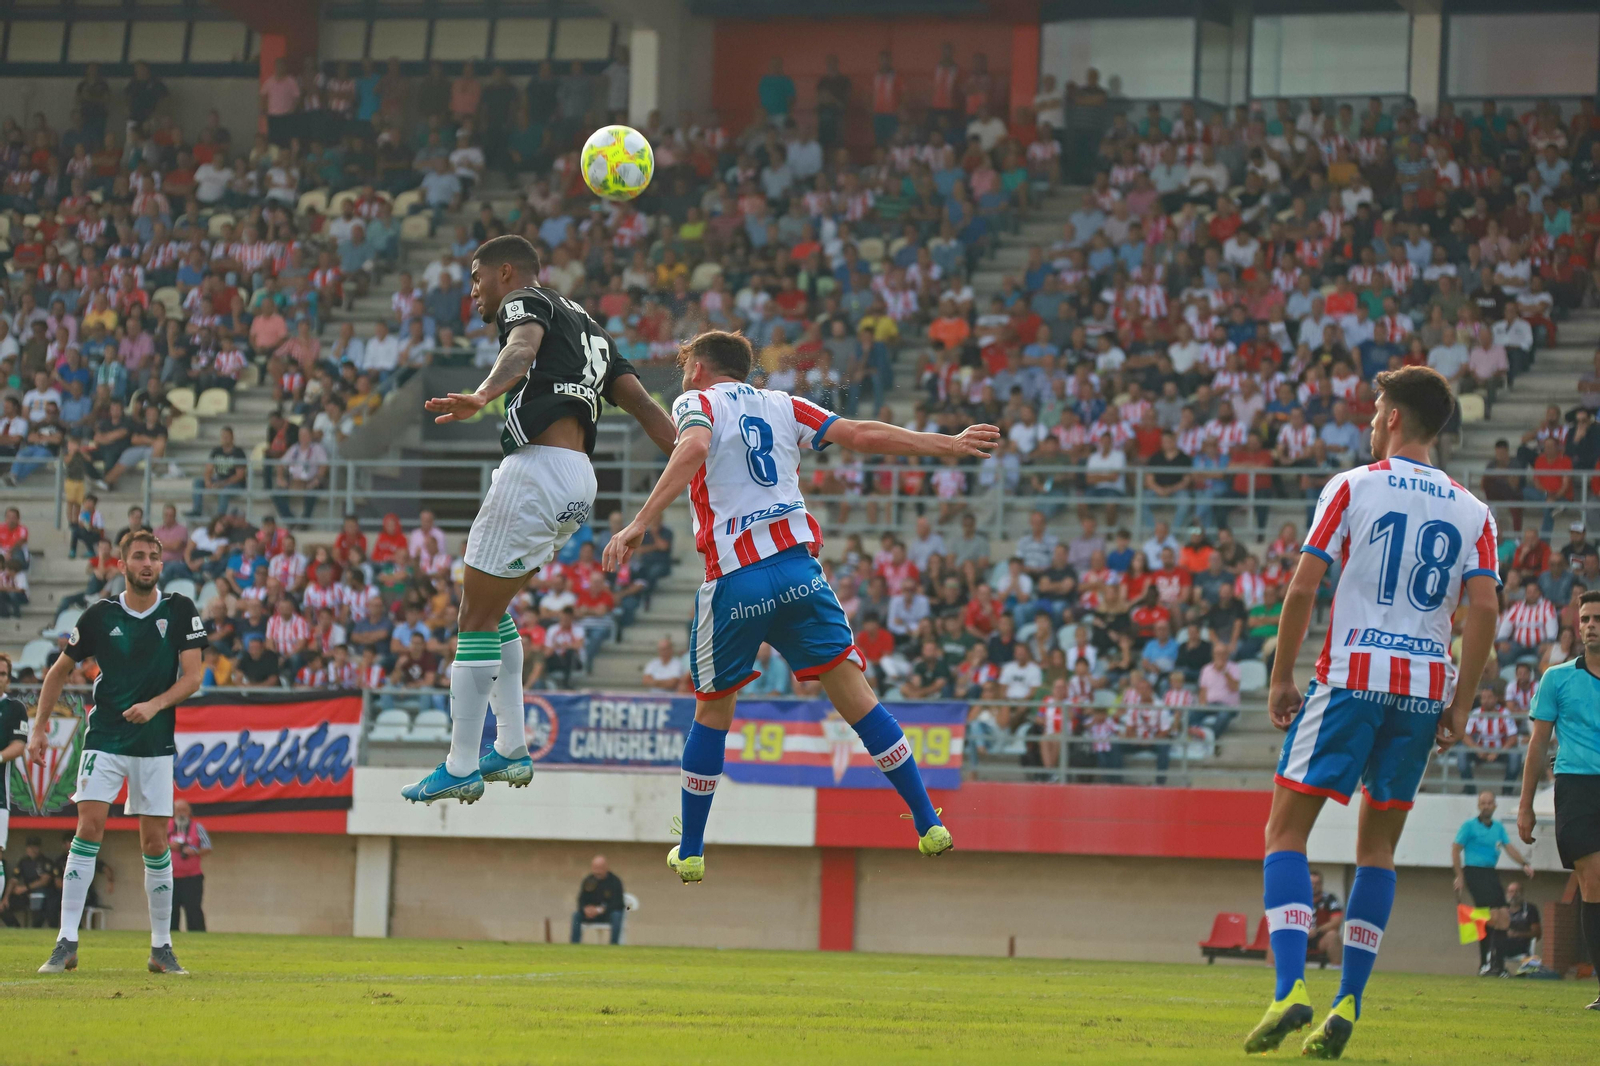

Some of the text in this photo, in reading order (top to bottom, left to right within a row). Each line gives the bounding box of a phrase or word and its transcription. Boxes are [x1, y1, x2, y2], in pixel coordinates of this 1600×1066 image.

[739, 414, 778, 488] 8
[1387, 475, 1456, 501] CATURLA
[1369, 510, 1462, 612] 18
[588, 700, 673, 731] FRENTE
[173, 721, 353, 791] ecirista
[740, 722, 786, 762] 19
[876, 743, 909, 770] 1909
[80, 752, 98, 777] 14
[686, 776, 717, 792] 1909
[1349, 925, 1380, 950] 1909
